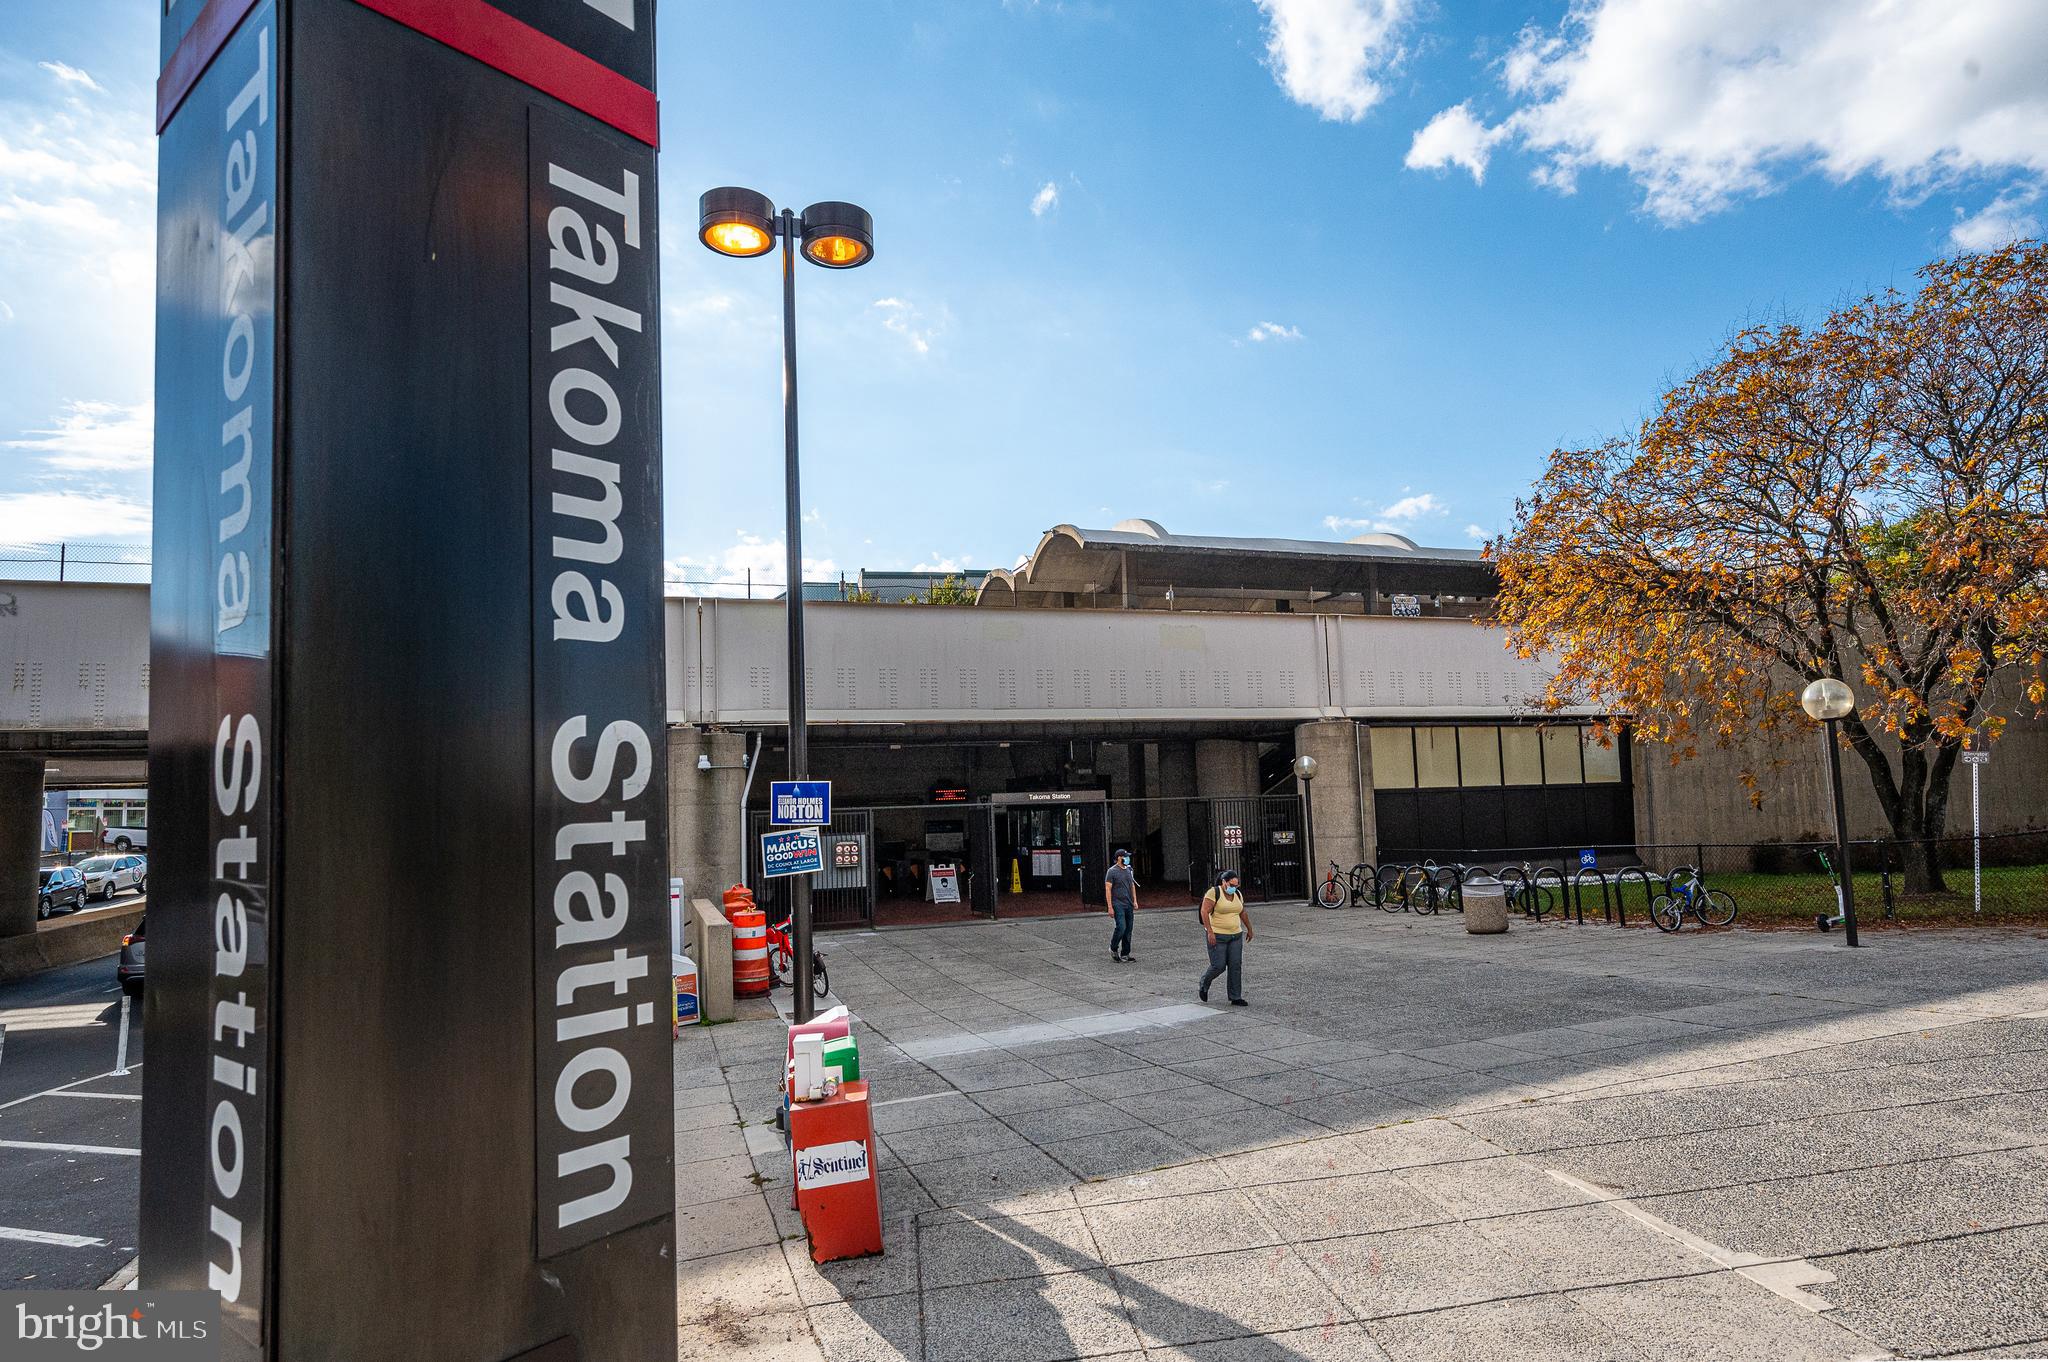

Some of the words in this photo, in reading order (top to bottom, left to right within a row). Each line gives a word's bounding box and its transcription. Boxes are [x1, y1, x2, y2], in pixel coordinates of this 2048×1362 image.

[217, 28, 269, 634] Takoma
[547, 162, 642, 643] Takoma
[767, 838, 817, 854] MARCUS
[767, 848, 817, 862] GOODWIN
[778, 804, 823, 819] NORTON
[208, 713, 262, 1303] Station
[551, 715, 652, 1229] Station
[812, 1150, 866, 1176] Sentinel
